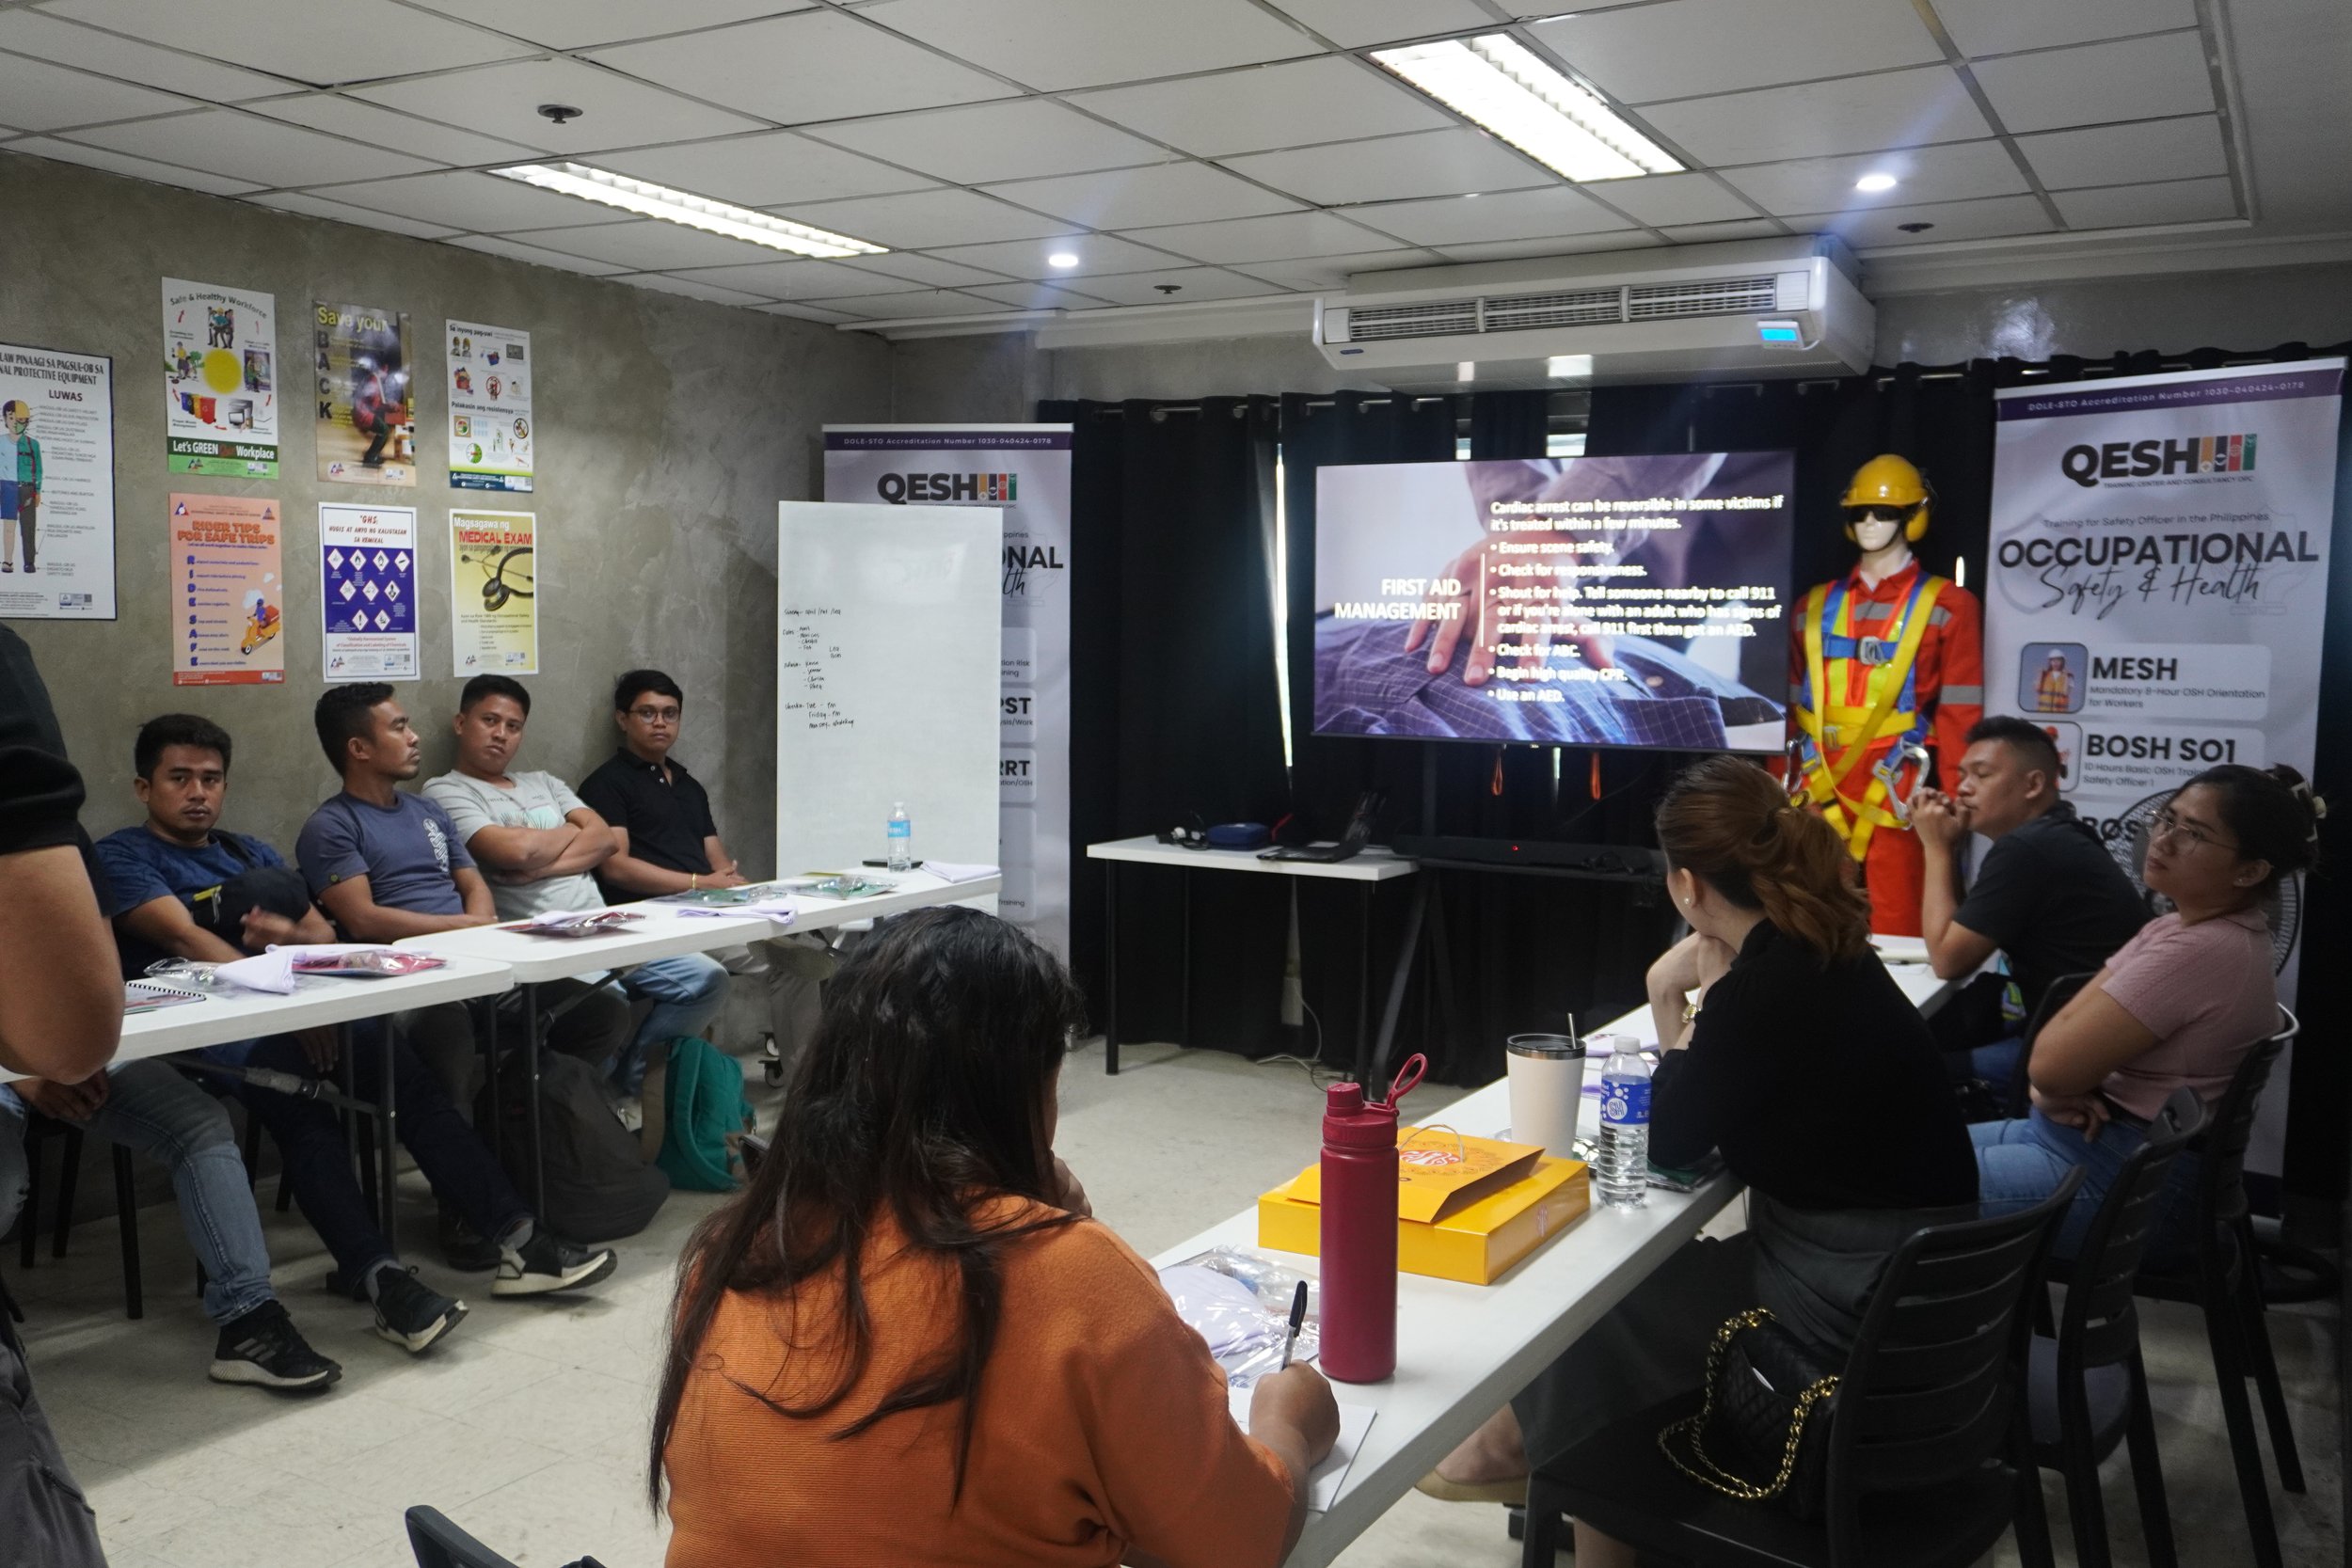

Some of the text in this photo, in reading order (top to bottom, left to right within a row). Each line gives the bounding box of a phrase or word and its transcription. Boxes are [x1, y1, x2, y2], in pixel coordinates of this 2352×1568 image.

[196, 293, 226, 304] Healthy
[228, 296, 267, 319] Workforce
[317, 306, 388, 333] Save your
[16, 354, 45, 367] PINAAGI
[46, 357, 56, 368] SA
[95, 364, 103, 374] SA
[13, 366, 56, 381] PROTECTIVE
[57, 372, 97, 386] EQUIPMENT
[48, 389, 83, 402] LUWAS
[2081, 393, 2155, 406] Accreditation
[2158, 389, 2201, 401] Number
[173, 440, 274, 460] Let's GREEN Workplace
[2061, 437, 2201, 488] QESH
[877, 472, 978, 505] QESH
[1490, 495, 1784, 515] Cardiac arrest can be reversible in some victims if
[192, 520, 261, 534] RIDER TIPS
[453, 516, 509, 531] Magsagawa ng
[1490, 516, 1681, 531] it's treated within a few minutes.
[2042, 512, 2270, 530] Training for Safety Officer in the Philippines
[177, 530, 275, 545] FOR SAFE TRIPS
[458, 531, 532, 545] MEDICAL EXAM
[1499, 541, 1614, 556] Ensure scene safety.
[1997, 531, 2320, 568] OCCUPATIONAL
[1498, 564, 1647, 579] Check for responsiveness.
[1381, 578, 1461, 596] FIRST AID
[1497, 586, 1775, 602] Shout for help. Tell someone nearby to call 911
[2040, 557, 2263, 621] Safety & Health
[1334, 602, 1461, 620] MANAGEMENT
[1497, 605, 1782, 621] or if you're alone with an adult who has signs of
[1497, 622, 1756, 639] cardiac arrest, call 911 first then get an AED.
[1496, 643, 1581, 657] Check for ABC.
[1496, 666, 1629, 683] Begin high quality CPR.
[2091, 657, 2178, 680] MESH
[1496, 689, 1565, 703] Use an AED.
[2090, 686, 2265, 699] Mandatory 8-Hour OSH Orientation
[2105, 699, 2143, 707] Workers
[2087, 734, 2235, 763] BOSH SO1
[2096, 763, 2122, 773] Hours
[2125, 765, 2152, 774] Basic
[2154, 767, 2175, 775] OSH
[2083, 775, 2112, 784] Safety
[2116, 777, 2148, 786] Officer
